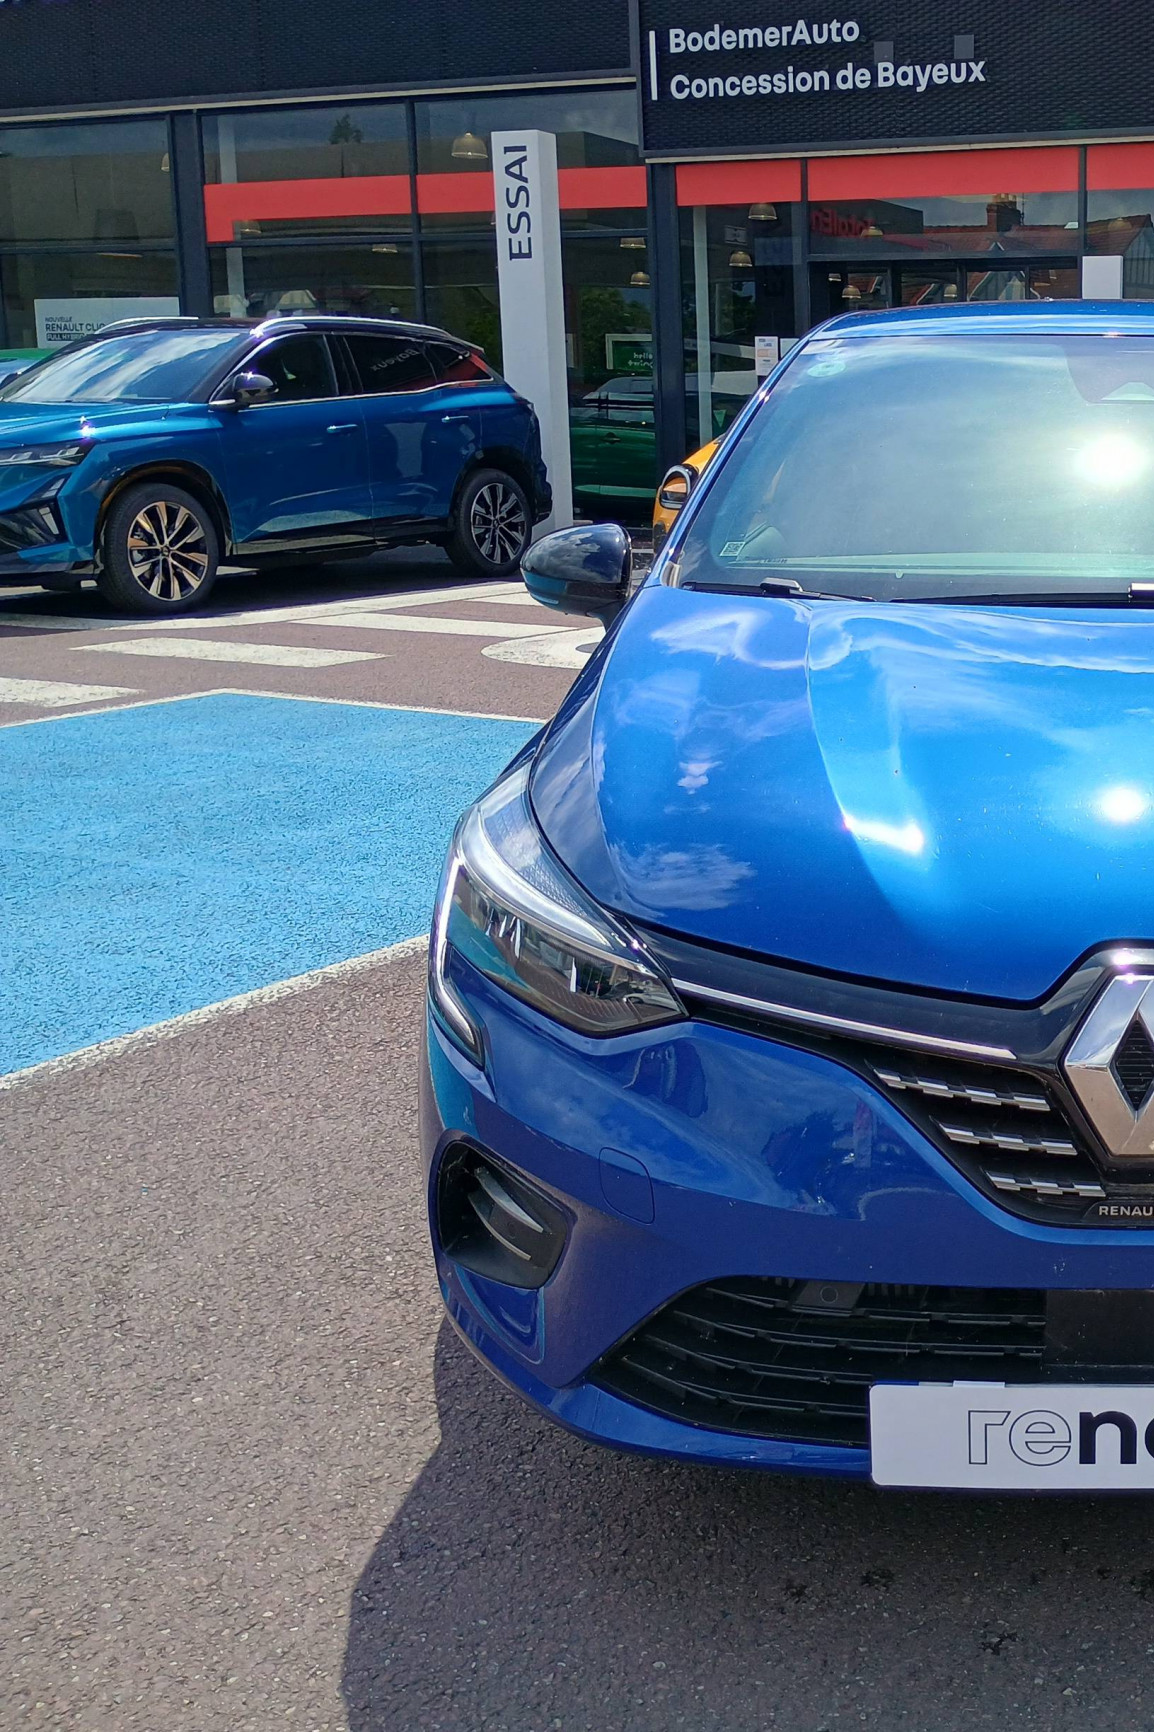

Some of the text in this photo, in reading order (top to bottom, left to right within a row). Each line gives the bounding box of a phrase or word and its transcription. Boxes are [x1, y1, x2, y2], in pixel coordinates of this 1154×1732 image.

[669, 19, 860, 53] BodemerAuto
[670, 60, 986, 100] Concession de Bayeux
[503, 145, 532, 261] ESSAI
[45, 323, 83, 332] RENAULT
